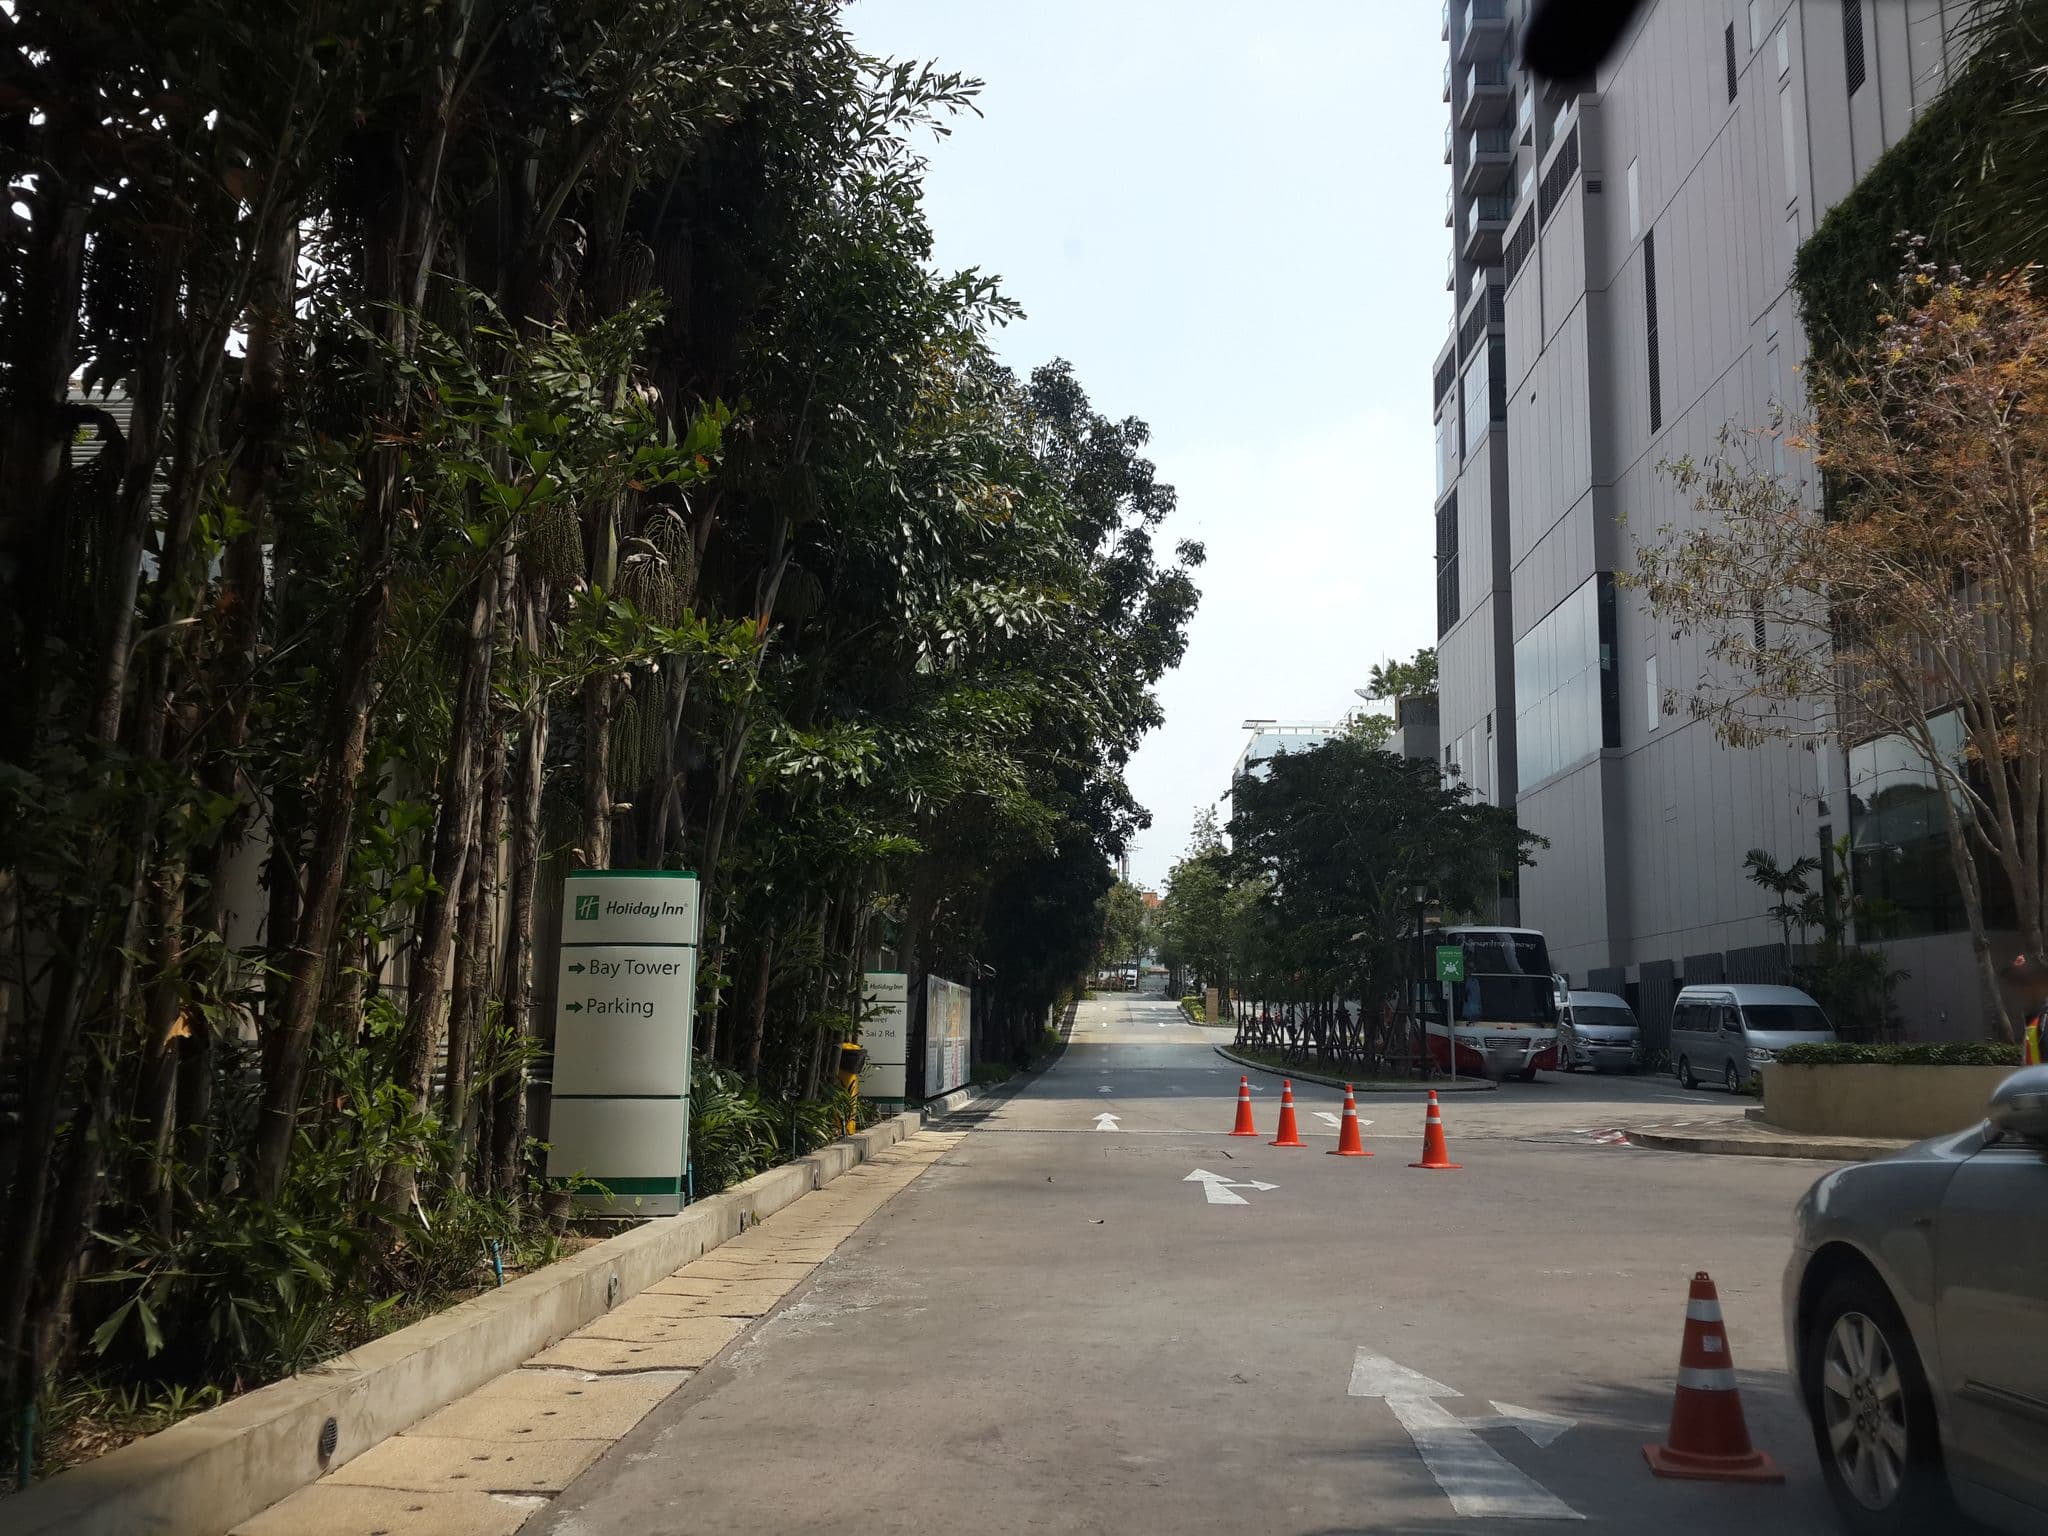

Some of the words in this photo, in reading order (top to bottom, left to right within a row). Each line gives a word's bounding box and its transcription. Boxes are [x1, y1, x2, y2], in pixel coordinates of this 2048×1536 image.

[606, 901, 660, 919] Holiday
[662, 901, 684, 916] Inn
[589, 959, 621, 979] Bay
[624, 959, 681, 976] Tower
[870, 983, 893, 991] Holiday
[587, 998, 654, 1018] Parking
[865, 1030, 877, 1038] Sai
[879, 1030, 884, 1038] 2
